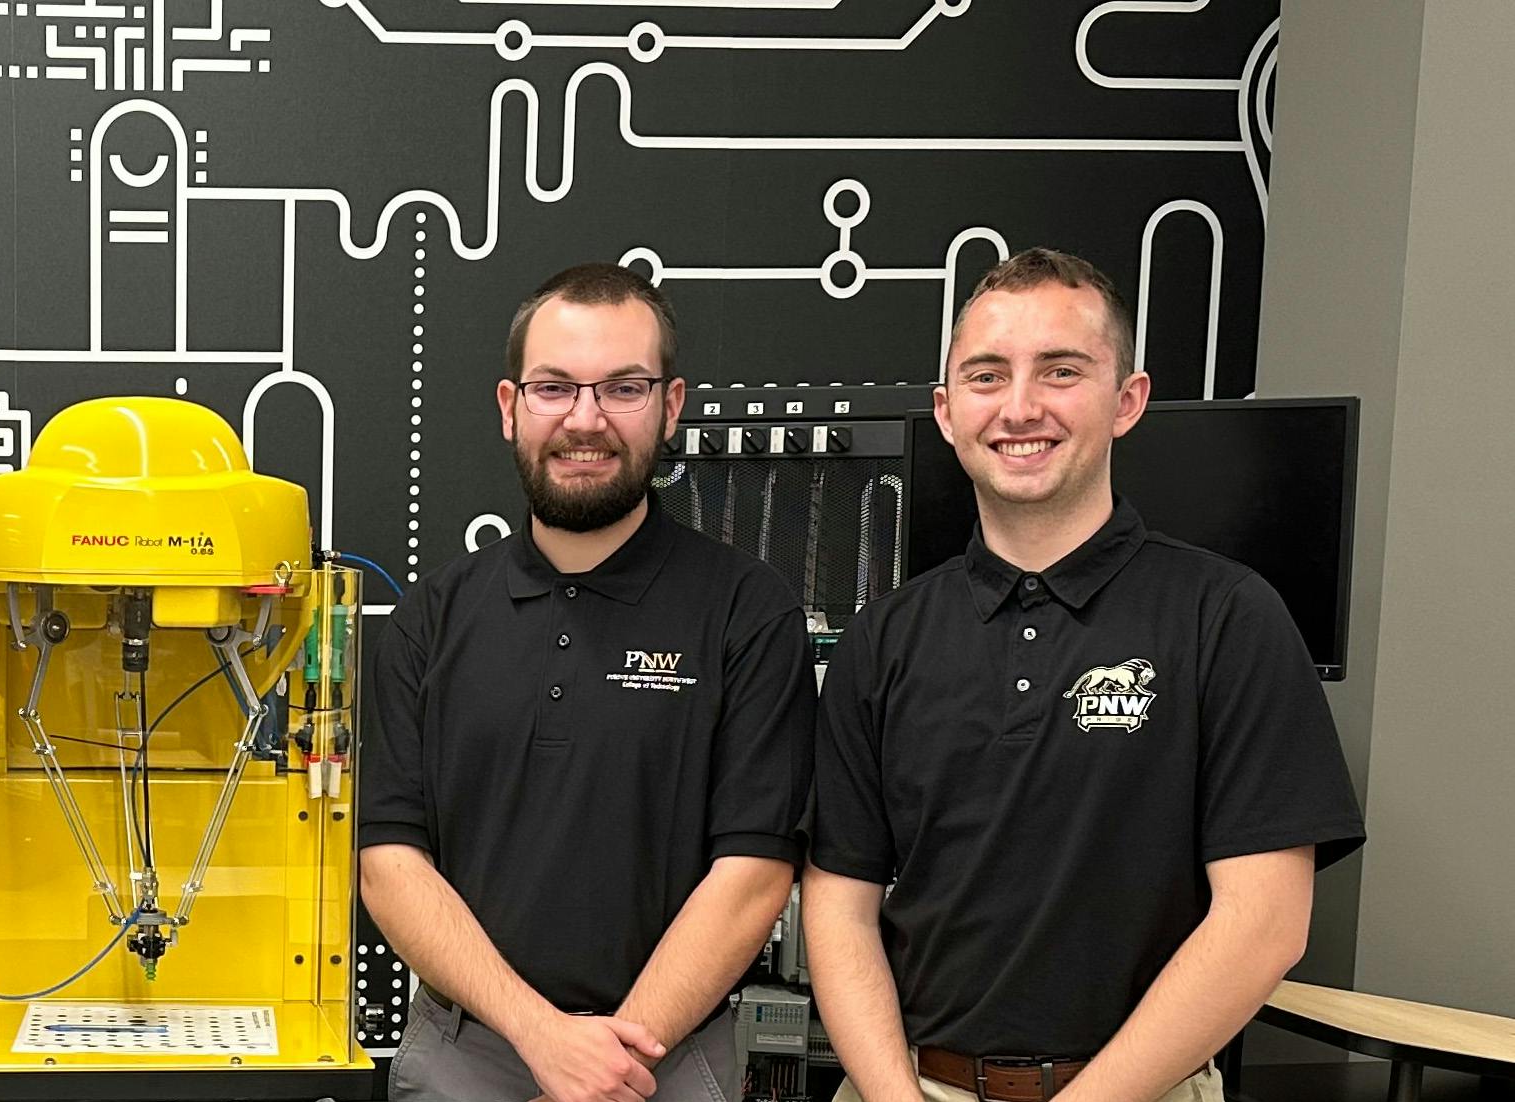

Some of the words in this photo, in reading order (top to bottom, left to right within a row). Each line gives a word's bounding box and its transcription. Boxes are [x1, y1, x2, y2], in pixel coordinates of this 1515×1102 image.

[709, 405, 716, 414] 2
[752, 405, 760, 414] 3
[791, 404, 799, 412] 4
[839, 404, 847, 413] 5
[72, 535, 130, 546] FANUC
[135, 535, 163, 547] Robot
[623, 650, 683, 670] PNW
[1080, 695, 1150, 715] PNW
